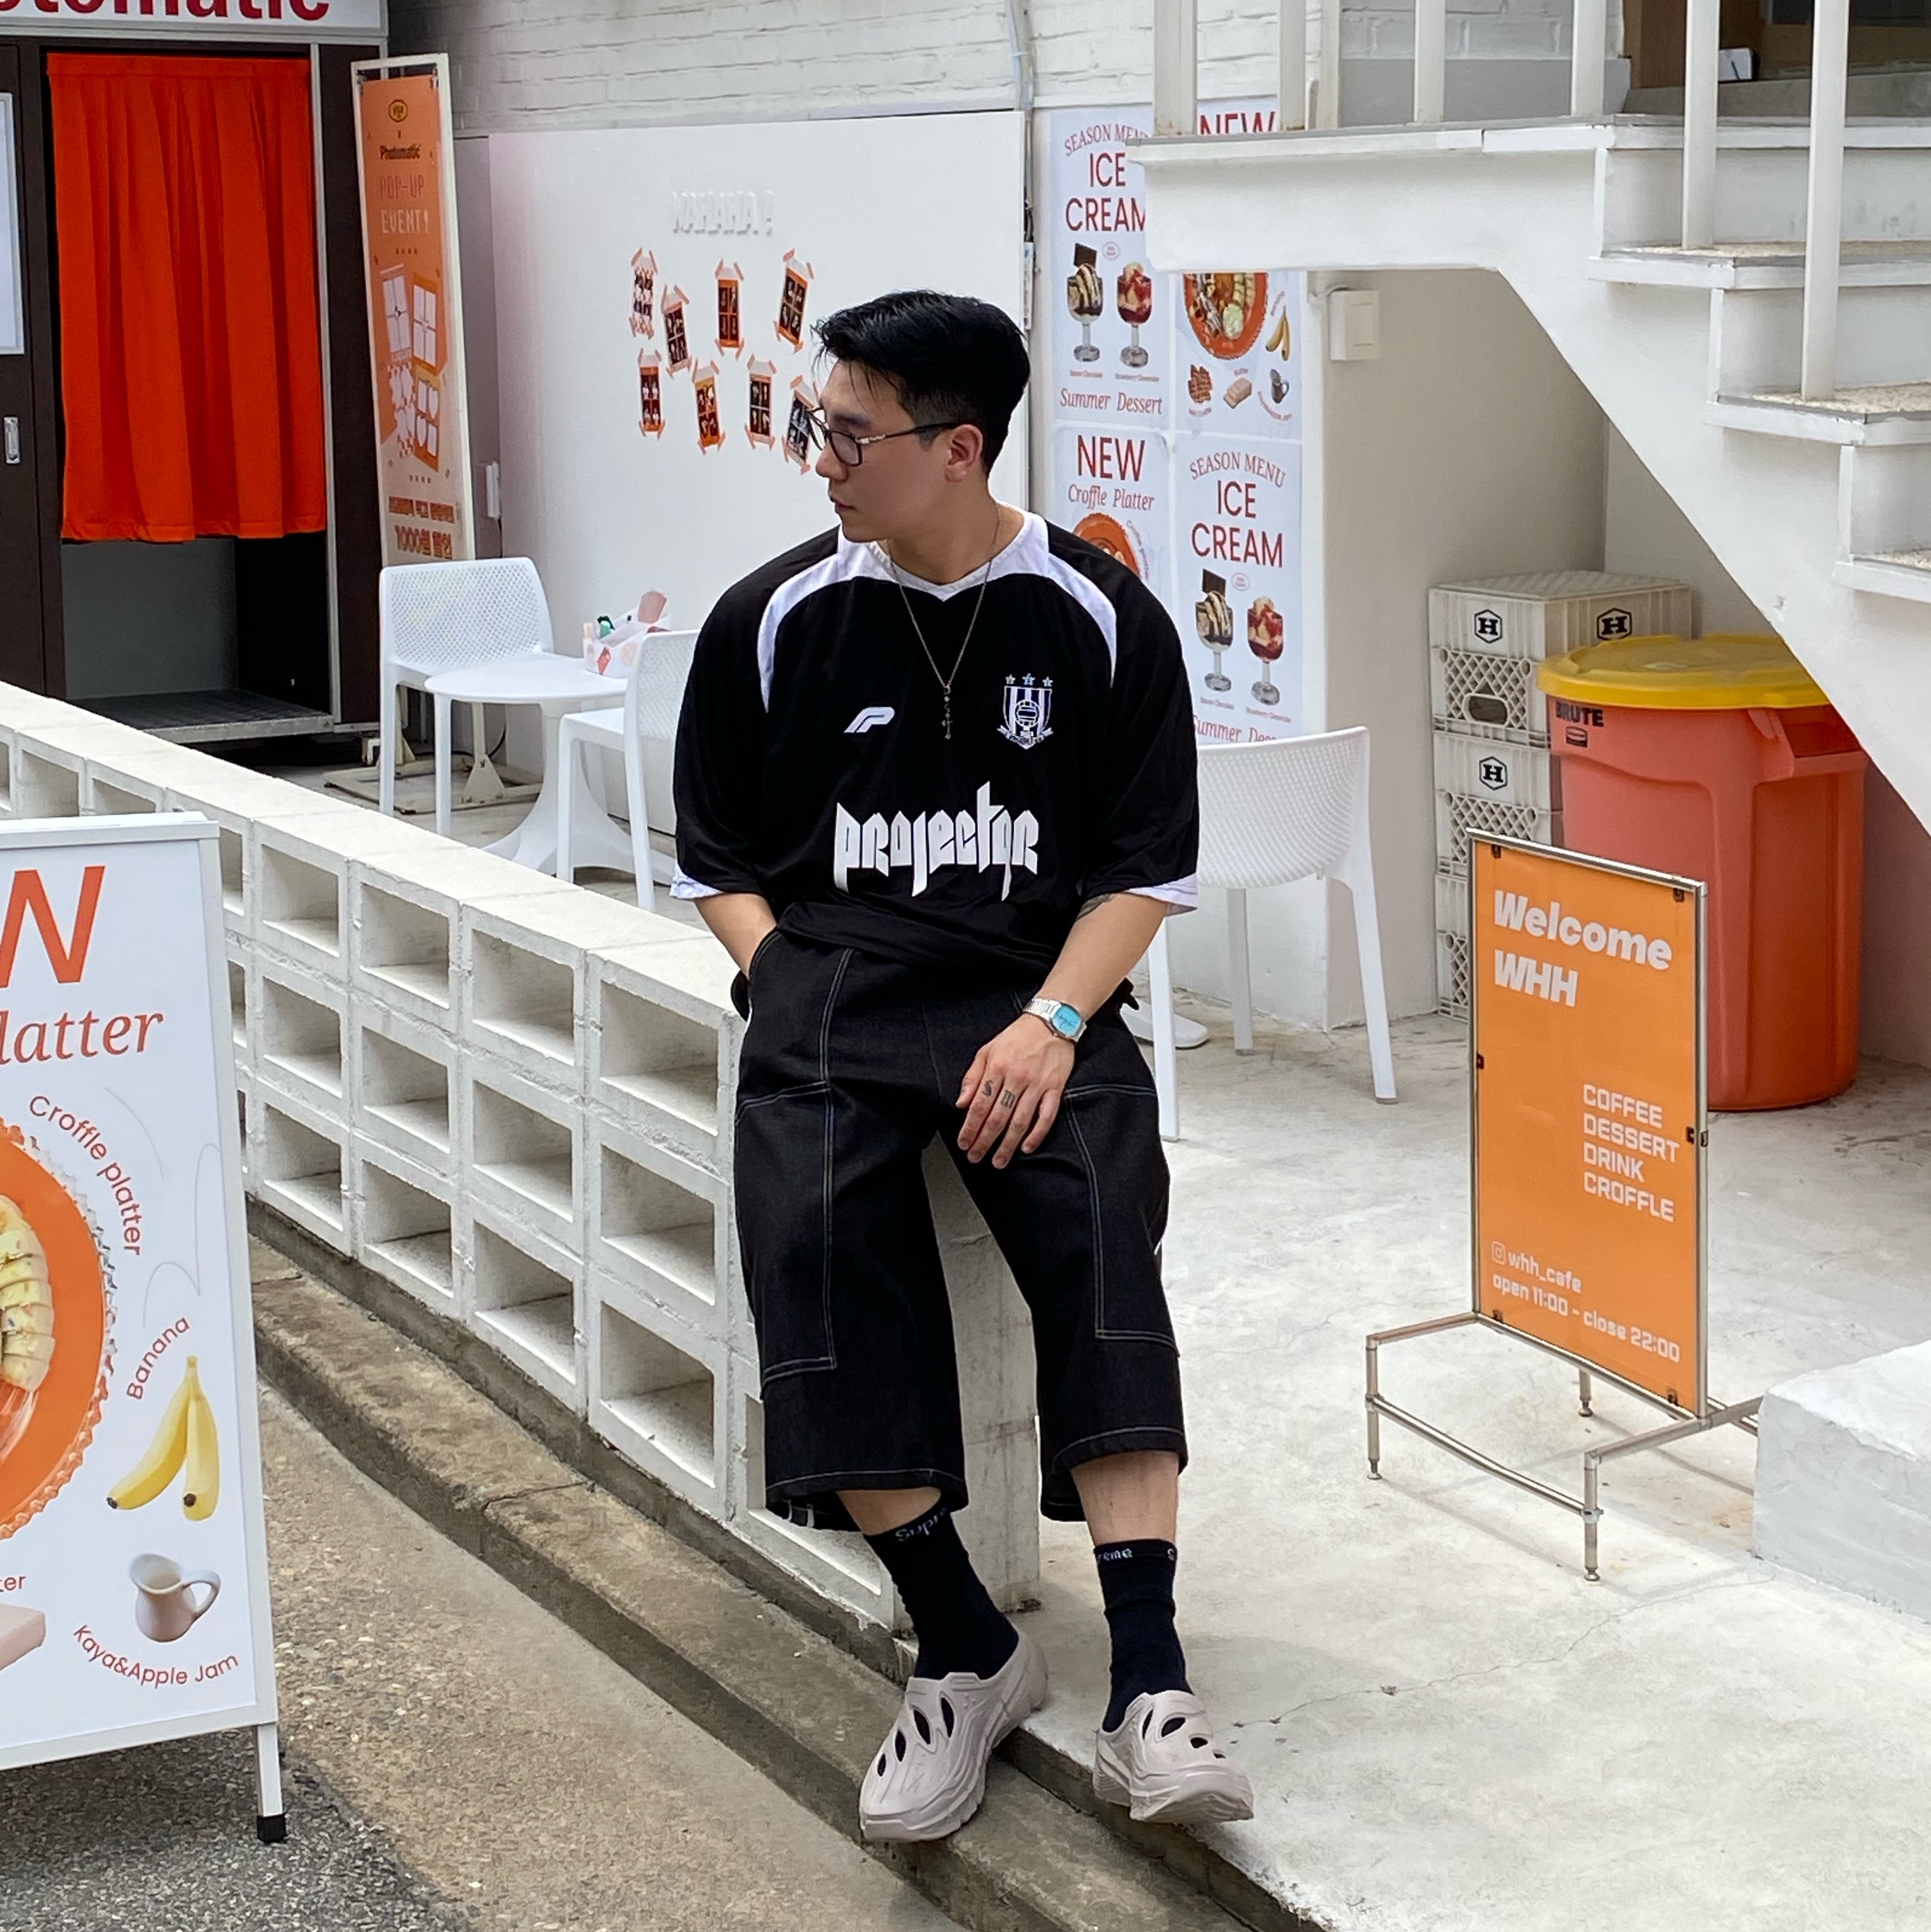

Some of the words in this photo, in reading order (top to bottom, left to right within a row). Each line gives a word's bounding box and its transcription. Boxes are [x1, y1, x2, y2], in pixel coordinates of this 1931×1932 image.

[1064, 123, 1112, 157] SEASON
[1089, 152, 1126, 187] ICE
[381, 209, 429, 234] EVENT!
[1065, 197, 1146, 232] CREAM
[1059, 388, 1111, 410] Summer
[1117, 392, 1162, 415] Dessert
[1077, 434, 1146, 482] NEW
[1190, 451, 1241, 482] SEASON
[1245, 453, 1287, 489] MENU
[1068, 483, 1108, 510] Croffle
[1112, 487, 1155, 512] Platter
[1217, 480, 1257, 519] ICE
[1192, 521, 1284, 568] CREAM
[1478, 616, 1499, 637] H
[1601, 615, 1628, 636] H
[1555, 700, 1605, 727] BRUTE
[1483, 763, 1504, 783] H
[1494, 889, 1673, 970] Welcome
[1494, 949, 1579, 1007] WHH
[1583, 1083, 1663, 1129] COFFEE
[1583, 1112, 1680, 1164] DESSERT
[29, 1095, 107, 1160] Croffle
[96, 1162, 142, 1256] platter
[1583, 1141, 1645, 1183] DRINK
[1584, 1171, 1675, 1223] CROFFLE
[1508, 1251, 1582, 1293] whh_cafe
[1492, 1273, 1530, 1301] open
[1533, 1286, 1569, 1317] 11:00
[1583, 1309, 1627, 1341] close
[1630, 1326, 1680, 1363] 22:00
[126, 1316, 191, 1400] Banana
[73, 1624, 188, 1689] Kaya&Apple
[195, 1654, 239, 1682] Jam
